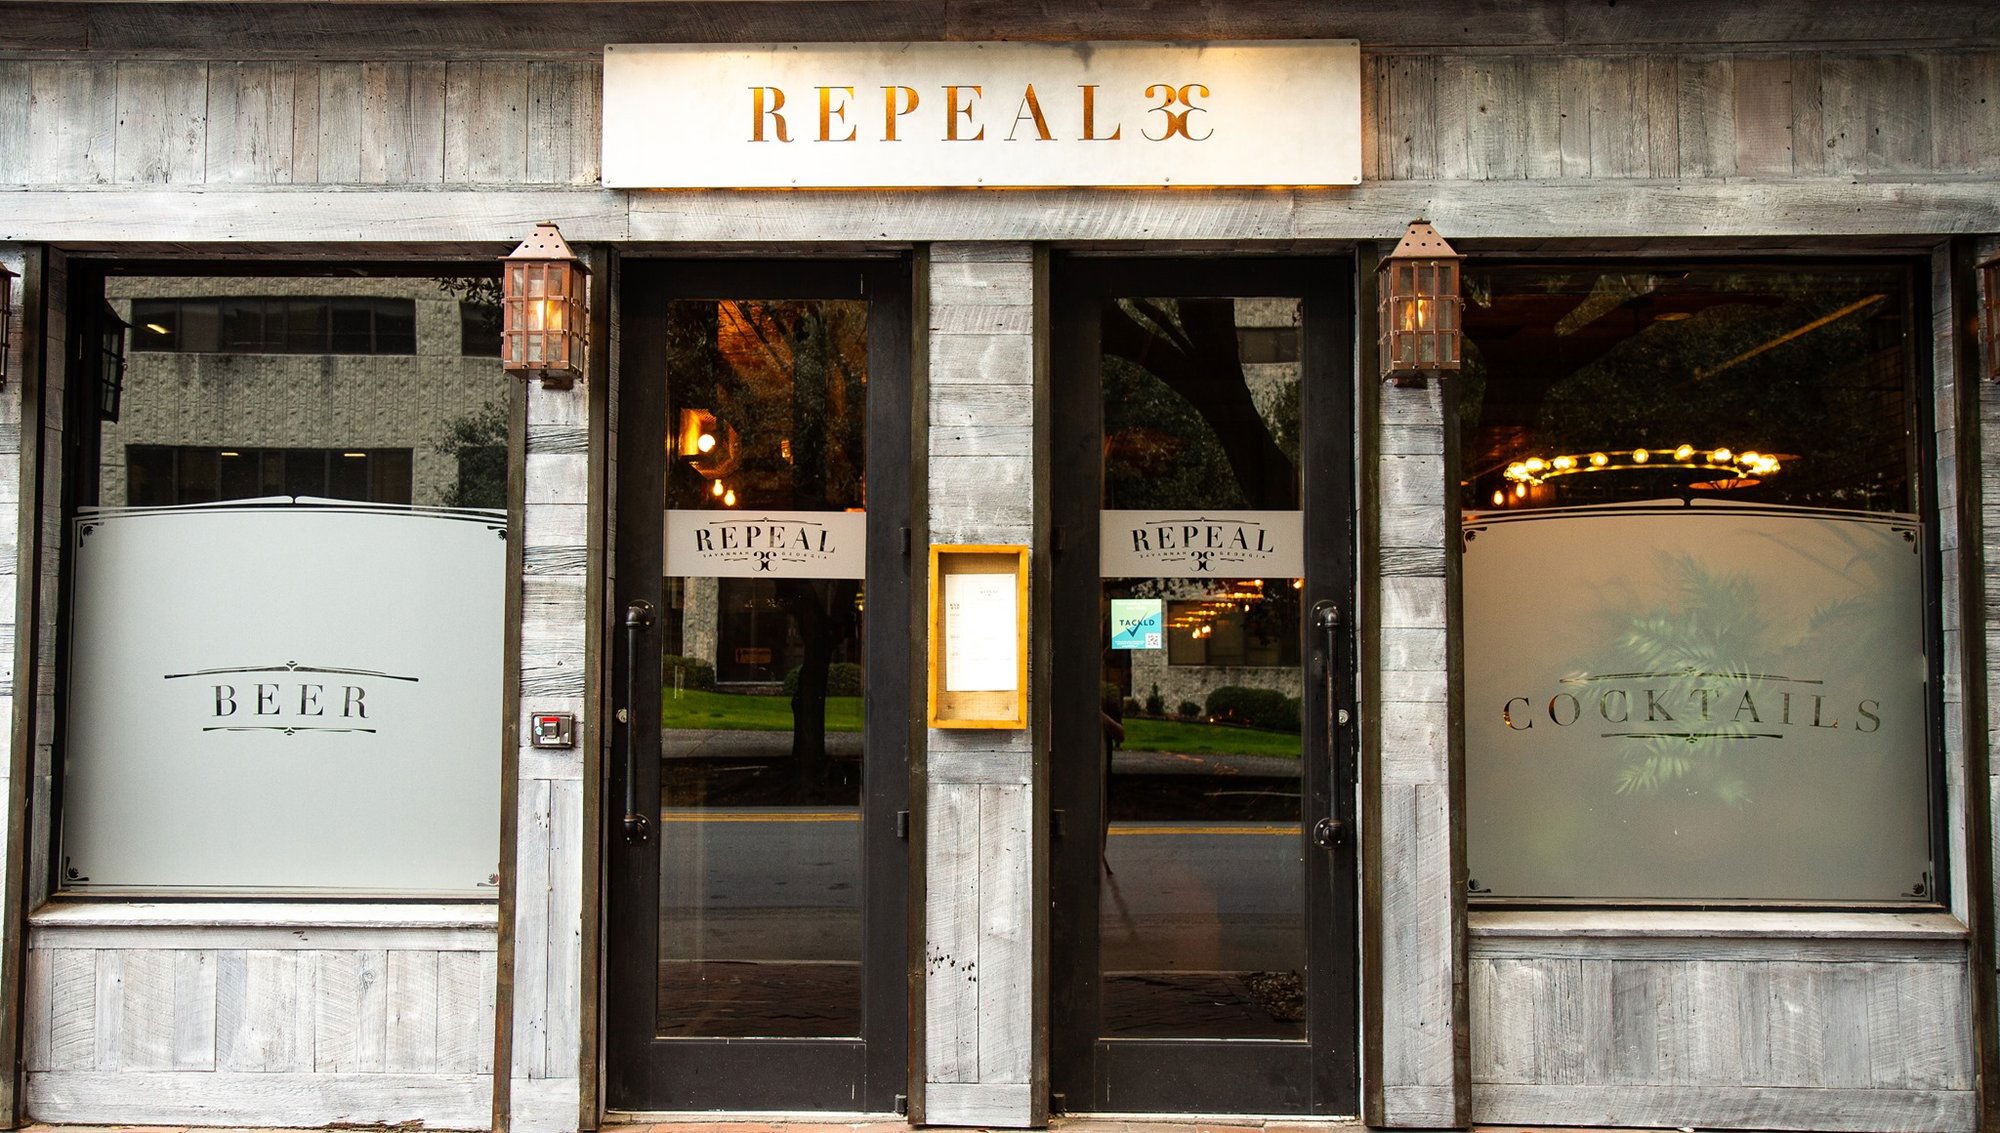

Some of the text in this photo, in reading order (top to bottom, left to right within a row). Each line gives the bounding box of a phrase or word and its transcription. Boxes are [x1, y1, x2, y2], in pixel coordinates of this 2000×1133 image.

[747, 83, 1121, 144] REPEAL
[693, 525, 836, 554] REPEAL
[1130, 525, 1275, 554] REPEAL
[702, 551, 750, 559] SAVANNAH
[781, 551, 828, 560] GEORGIA
[1139, 551, 1187, 559] SAVANNAH
[1219, 551, 1267, 560] GEORGIA
[210, 683, 370, 719] BEER
[1503, 688, 1881, 733] COCKTAILS
